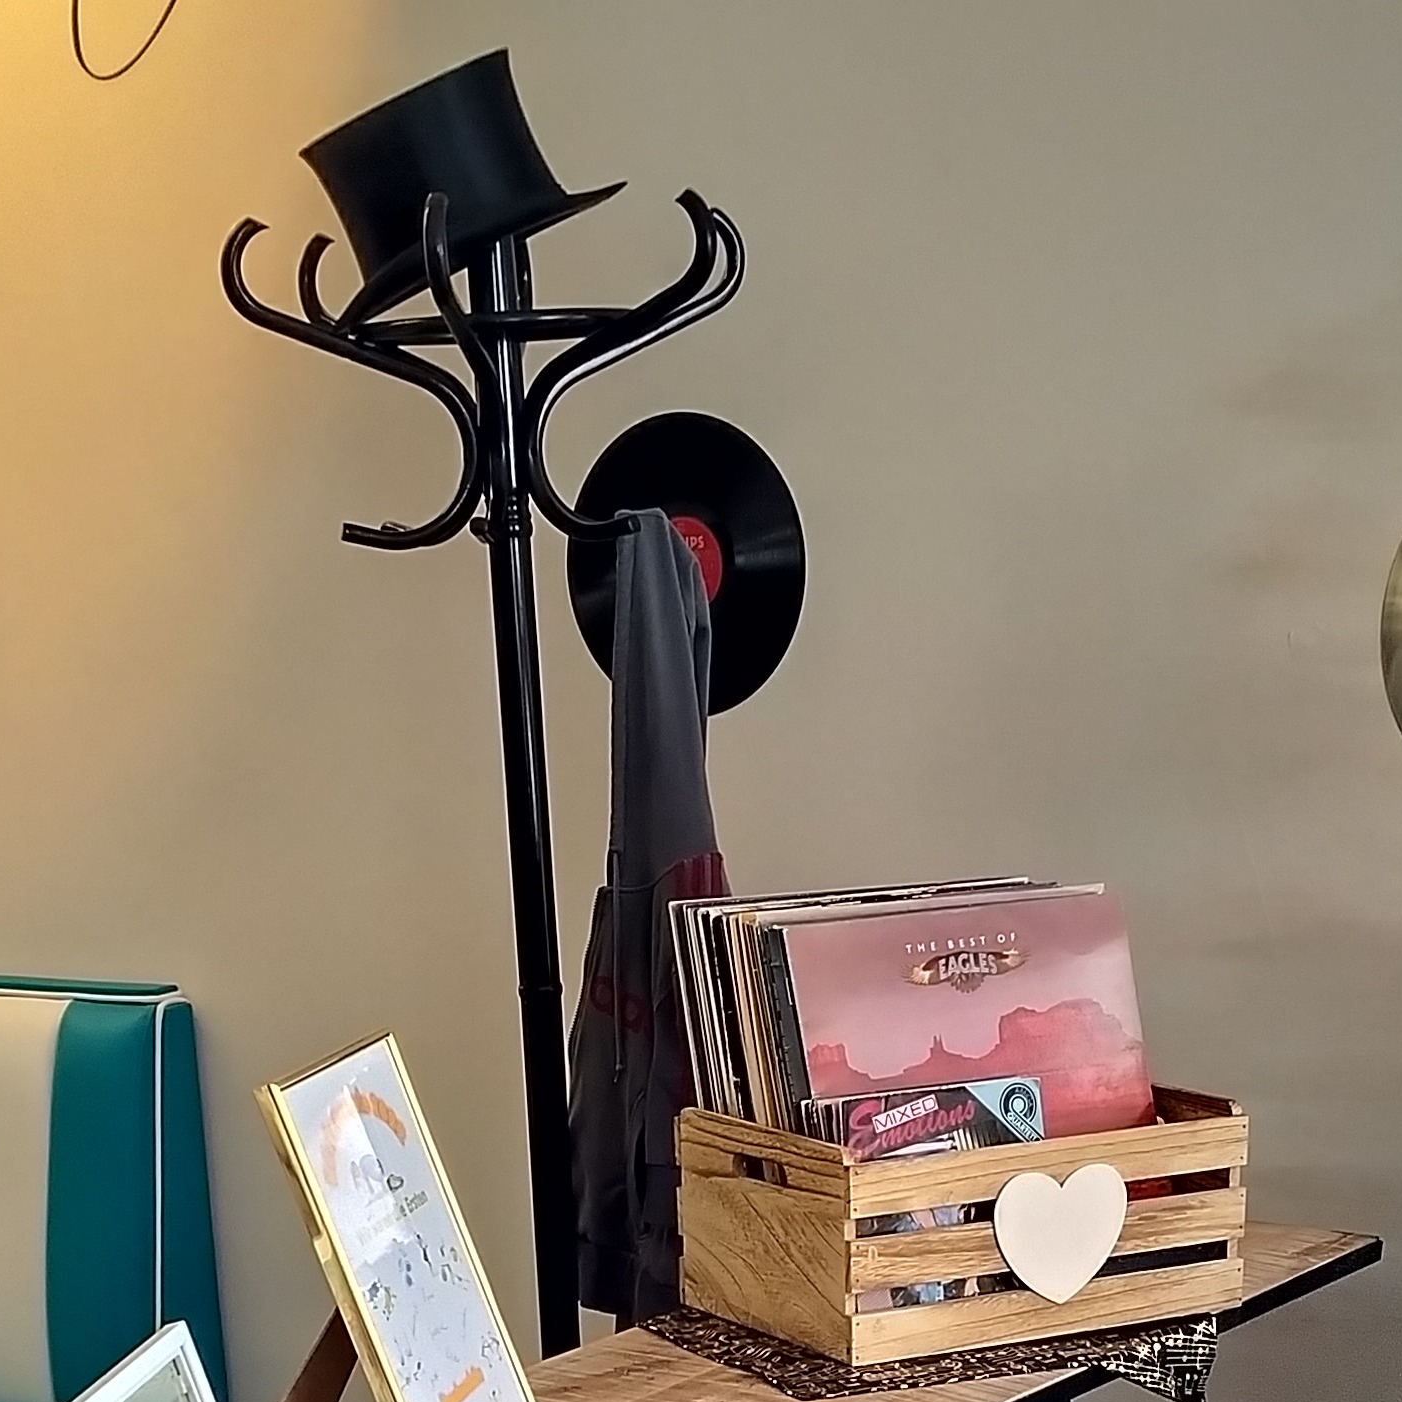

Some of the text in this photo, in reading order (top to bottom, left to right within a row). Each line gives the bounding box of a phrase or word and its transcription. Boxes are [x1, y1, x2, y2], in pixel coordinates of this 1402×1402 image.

[906, 932, 1016, 953] THE BEST OF
[938, 952, 998, 980] EAGLES
[873, 1097, 937, 1132] MIXED
[848, 1099, 977, 1162] Emotions
